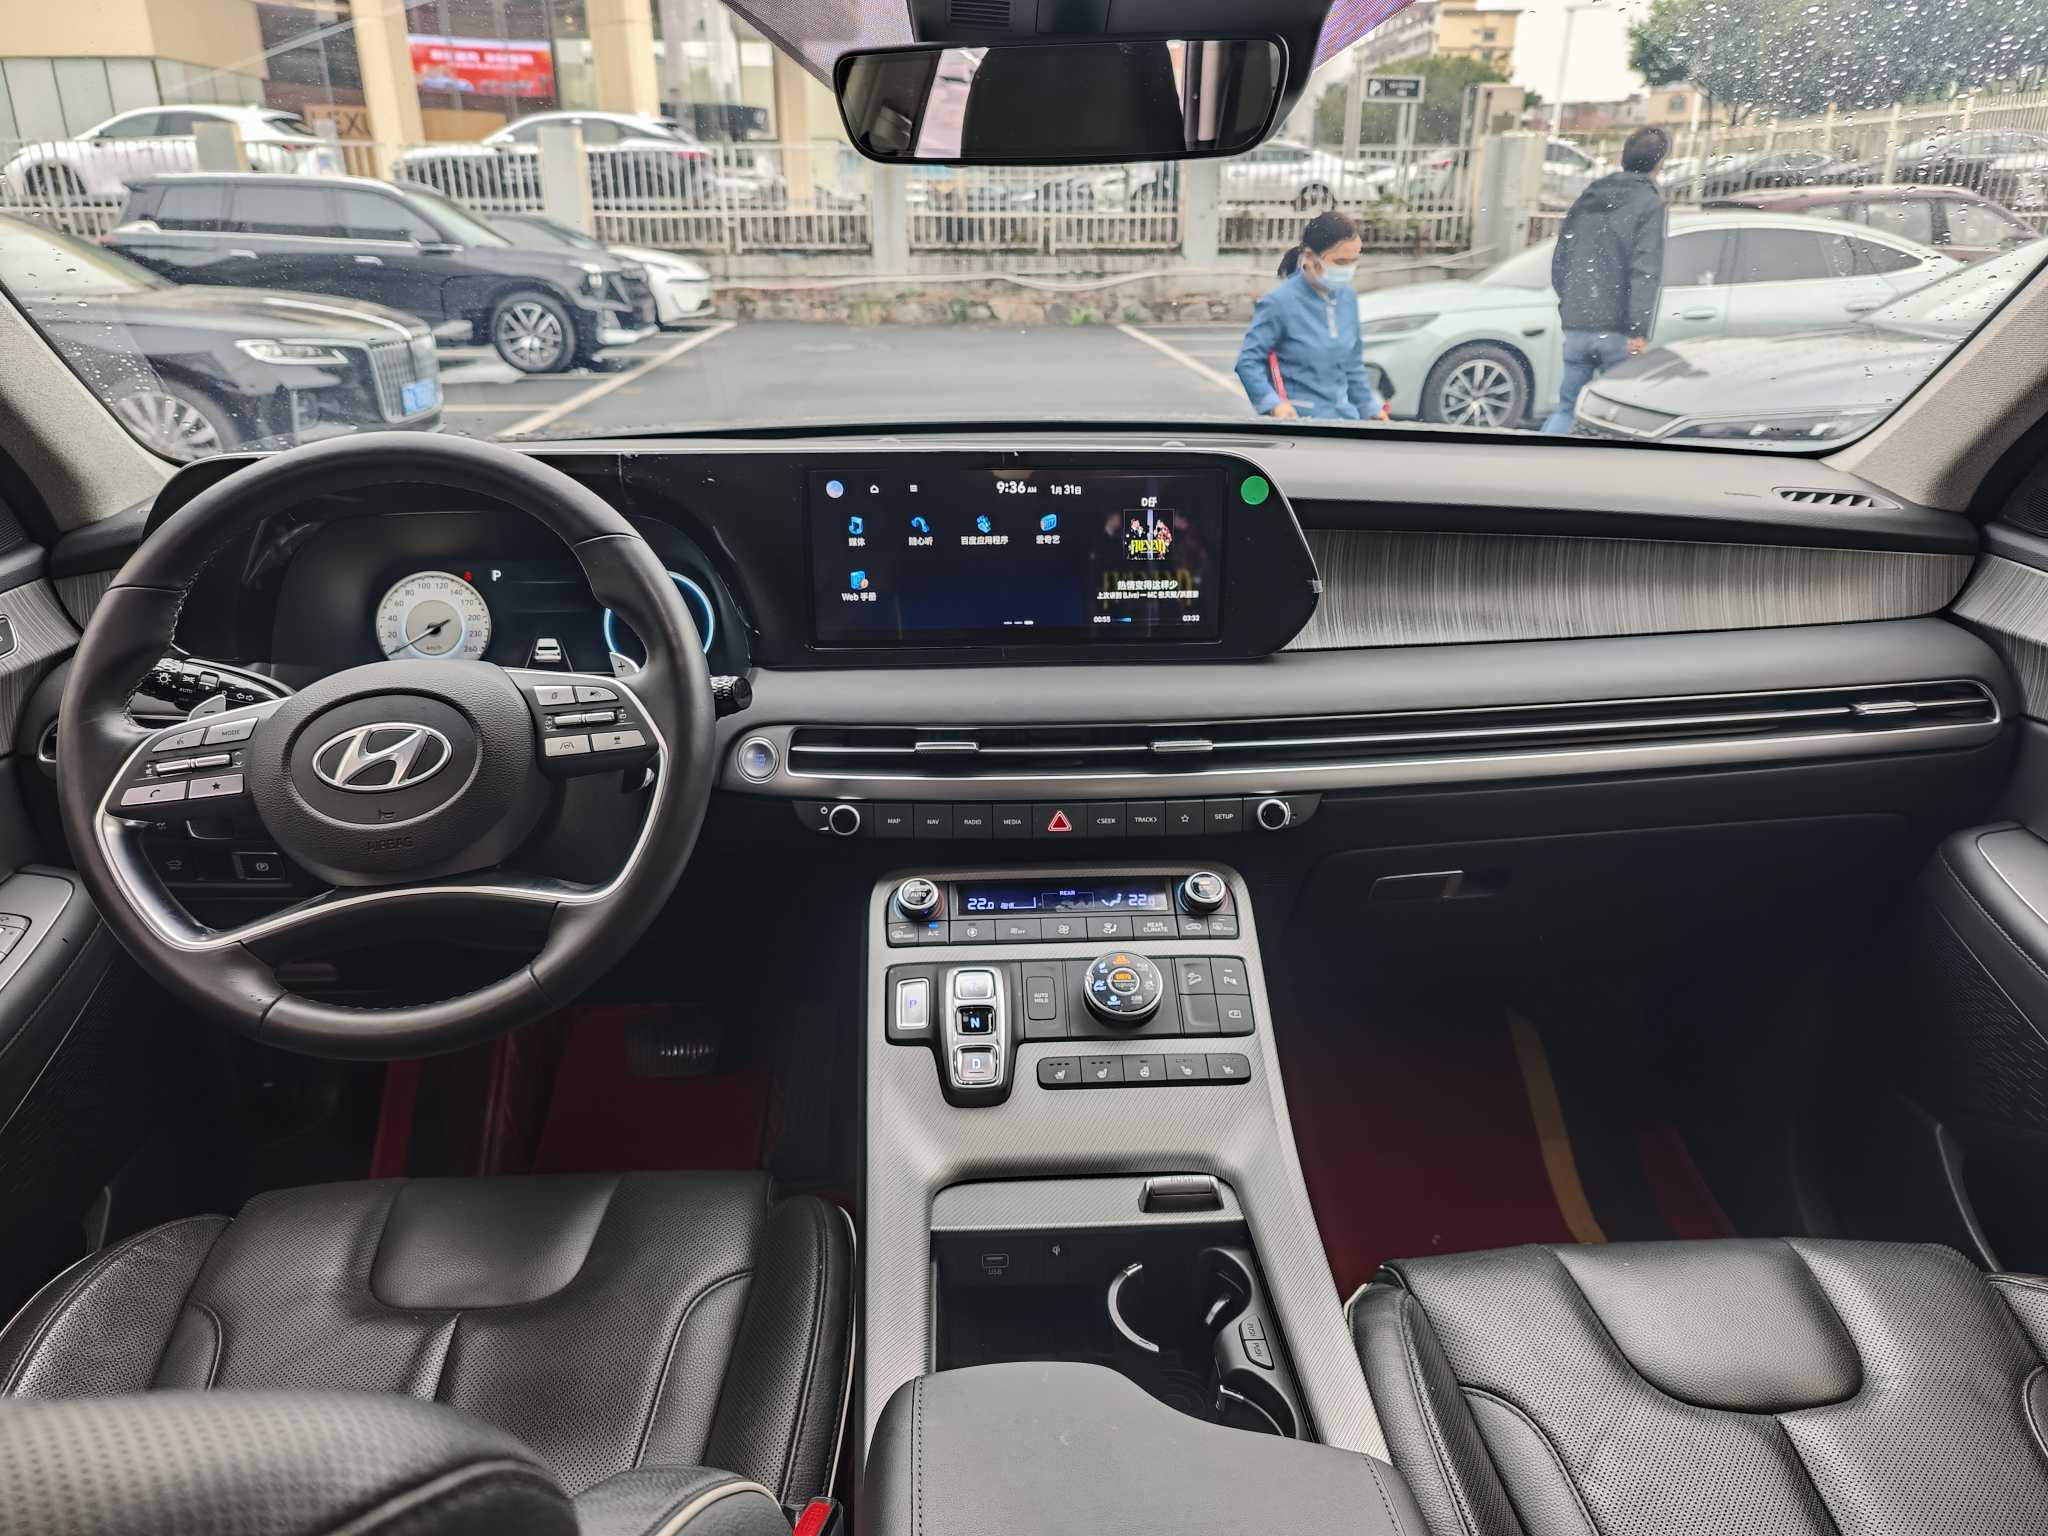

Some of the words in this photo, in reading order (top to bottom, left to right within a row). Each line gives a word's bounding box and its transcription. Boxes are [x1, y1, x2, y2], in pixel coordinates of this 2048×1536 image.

[996, 481, 1026, 494] 9:36
[491, 569, 501, 581] P
[841, 592, 859, 601] Web
[907, 1000, 917, 1008] P
[970, 1017, 980, 1028] N
[972, 1058, 981, 1069] D
